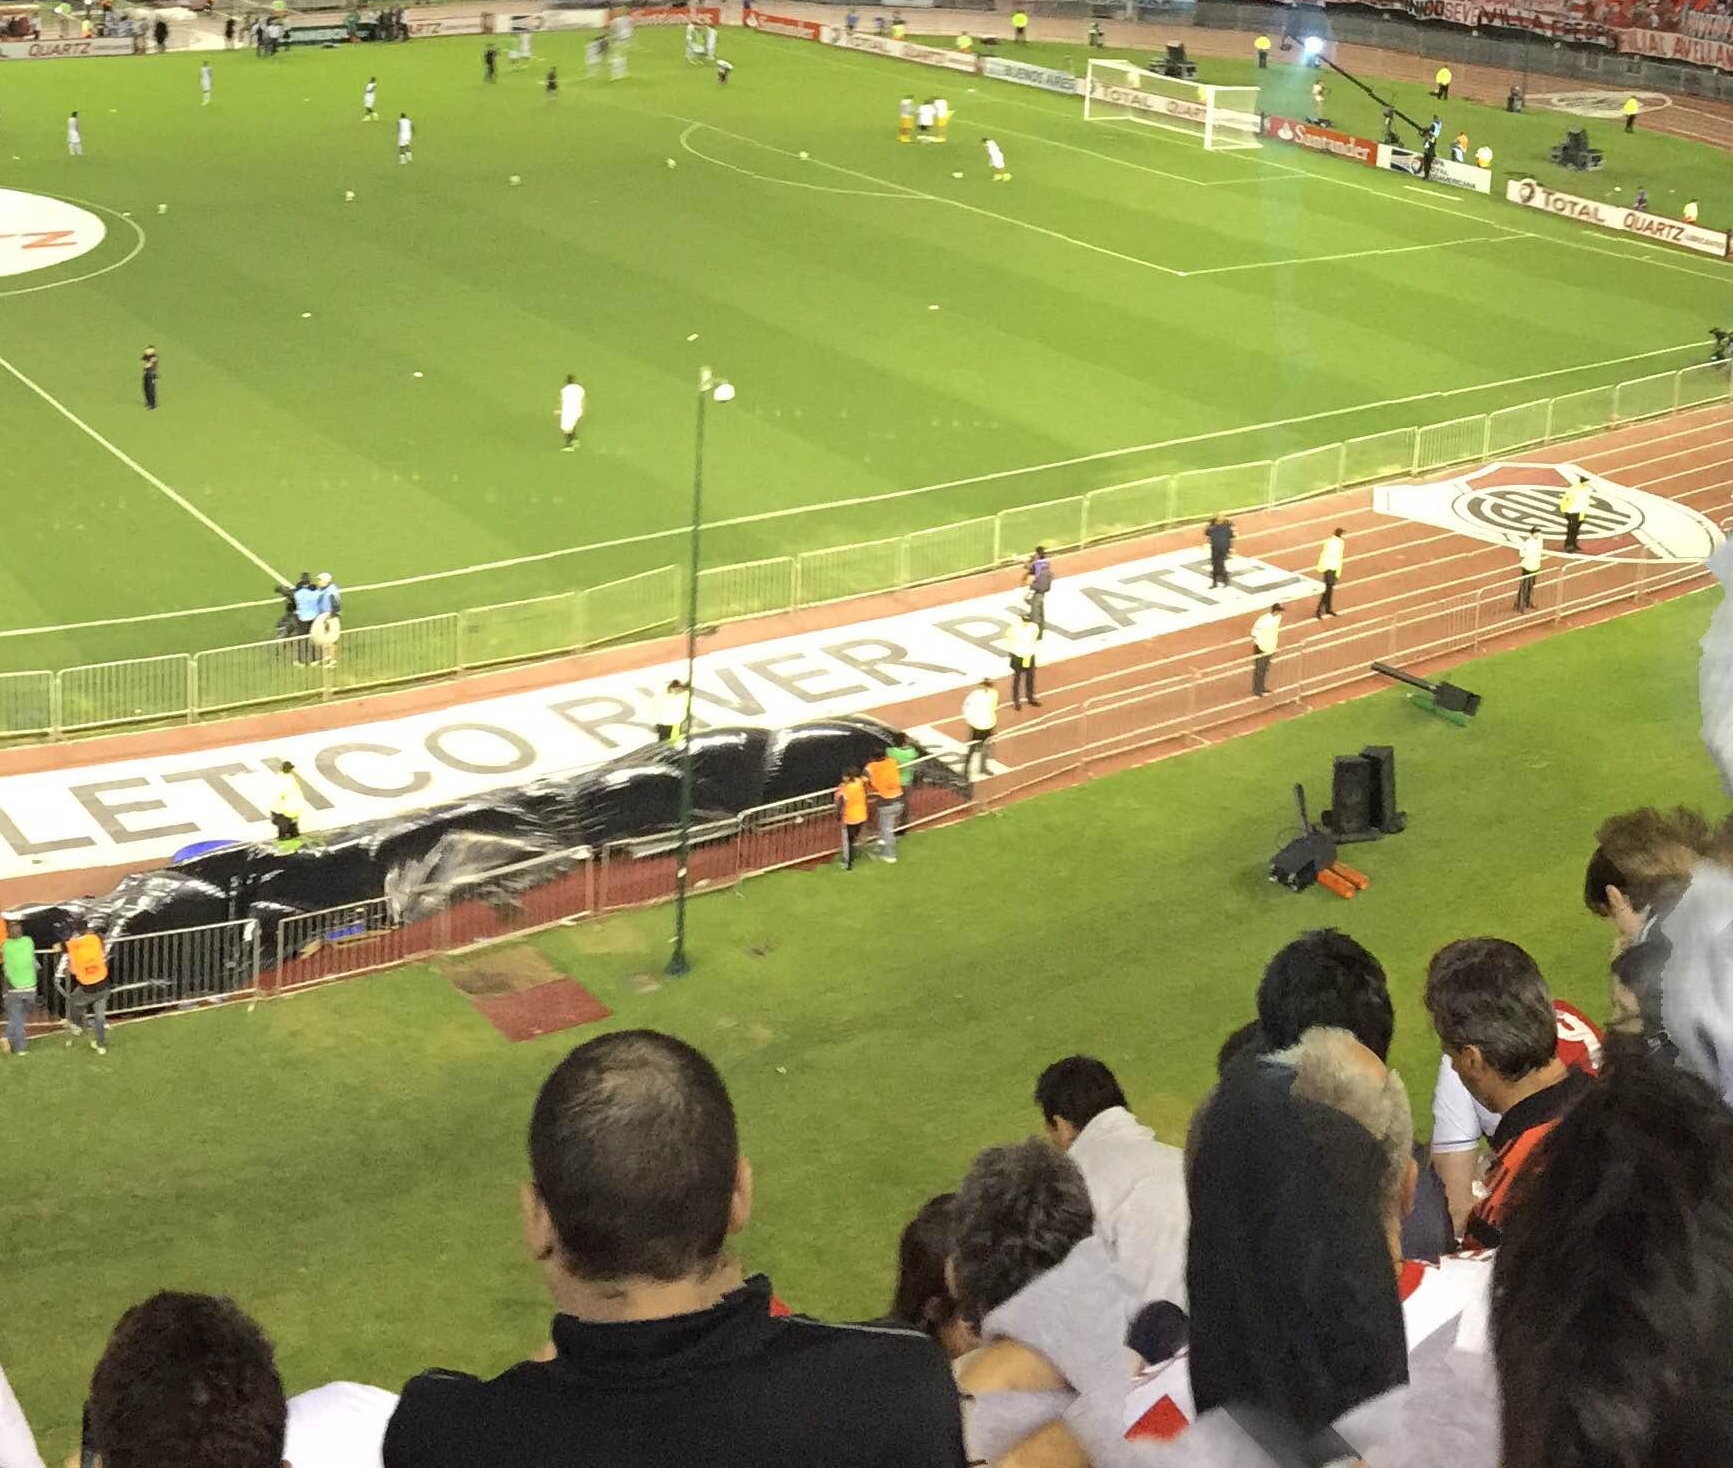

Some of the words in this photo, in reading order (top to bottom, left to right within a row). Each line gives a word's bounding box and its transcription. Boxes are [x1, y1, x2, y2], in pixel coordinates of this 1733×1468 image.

[28, 40, 91, 58] QUARTZ
[1102, 83, 1152, 109] TOTAL
[1294, 124, 1371, 161] Santander
[1541, 189, 1605, 224] TOTAL
[1622, 212, 1686, 242] QUARTZ
[932, 555, 1285, 660] PLATE
